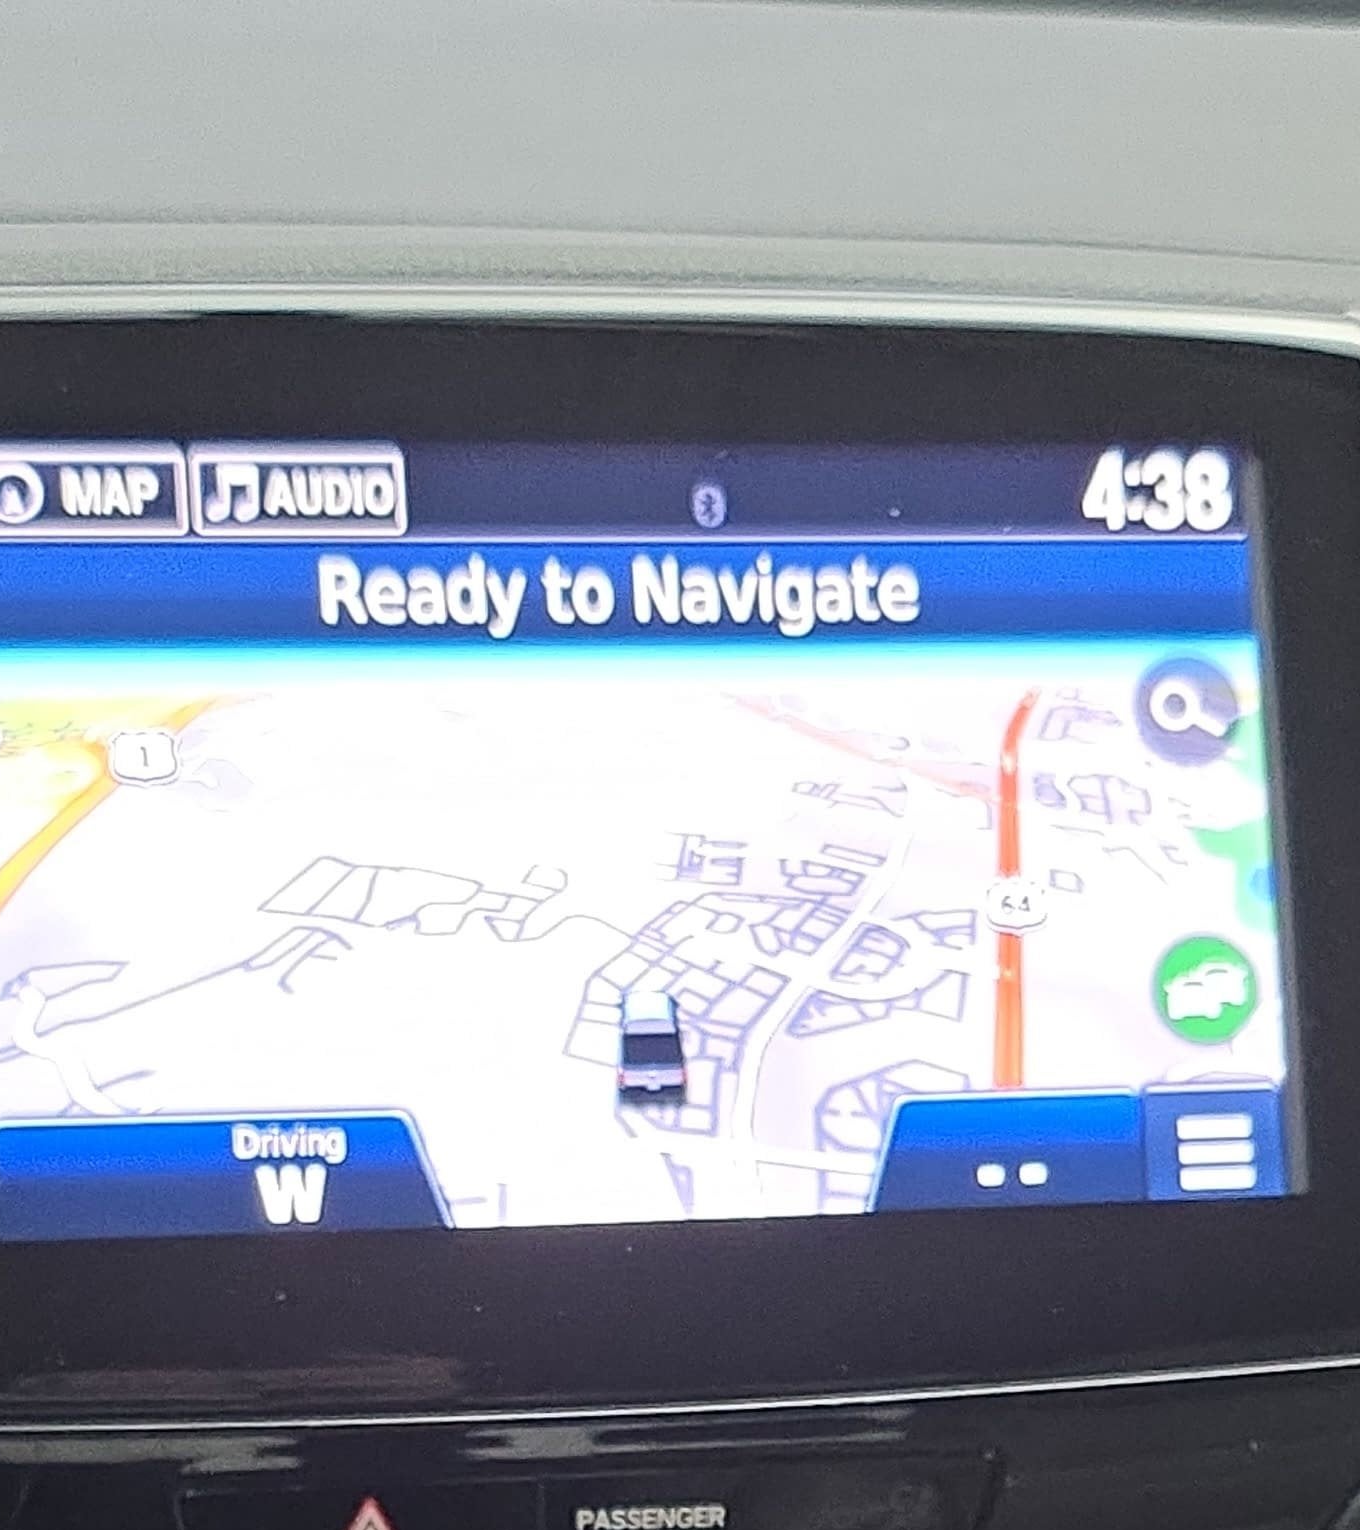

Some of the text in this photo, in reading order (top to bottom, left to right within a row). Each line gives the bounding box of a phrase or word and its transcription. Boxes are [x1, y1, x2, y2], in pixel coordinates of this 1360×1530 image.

[60, 468, 160, 516] MAP
[263, 466, 396, 517] AUDIO
[1082, 448, 1232, 532] 4:38
[318, 552, 921, 638] Ready to Navigate
[233, 1123, 347, 1164] Driving
[255, 1164, 328, 1224] W
